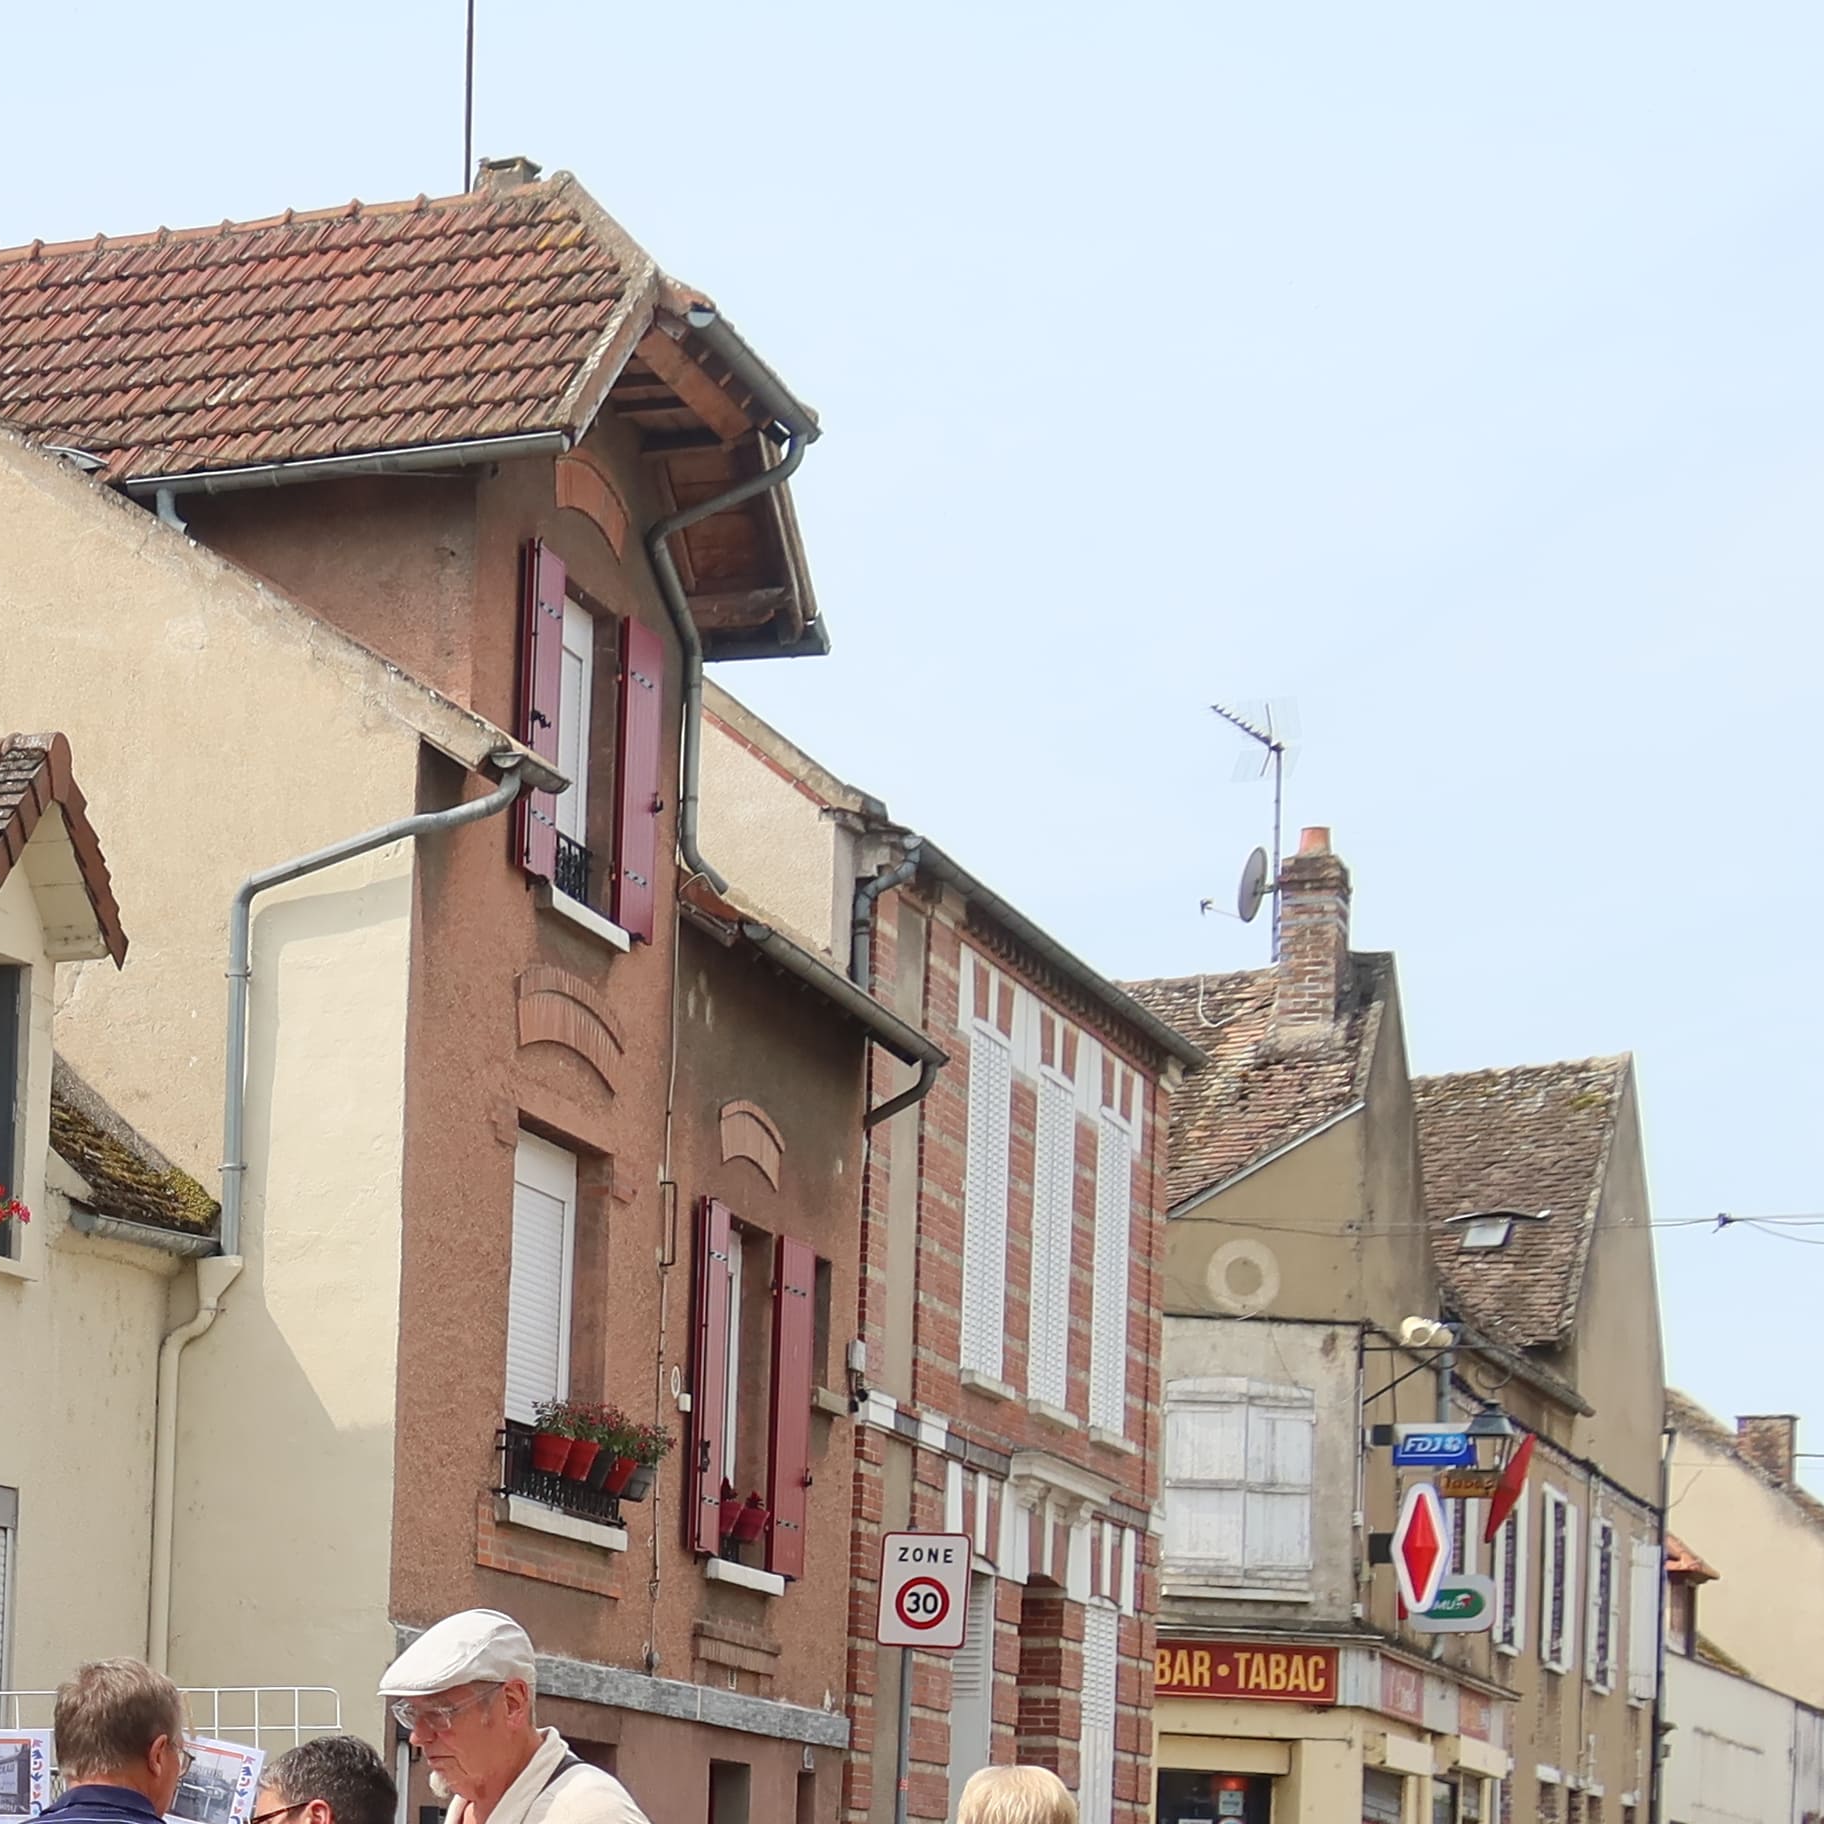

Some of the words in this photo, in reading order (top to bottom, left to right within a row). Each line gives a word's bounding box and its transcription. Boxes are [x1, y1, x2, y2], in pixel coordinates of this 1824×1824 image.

[1405, 1437, 1442, 1452] FDJ
[897, 1547, 953, 1563] ZONE
[906, 1591, 938, 1614] 30
[1155, 1649, 1211, 1687] BAR
[1233, 1651, 1326, 1692] TABAC
